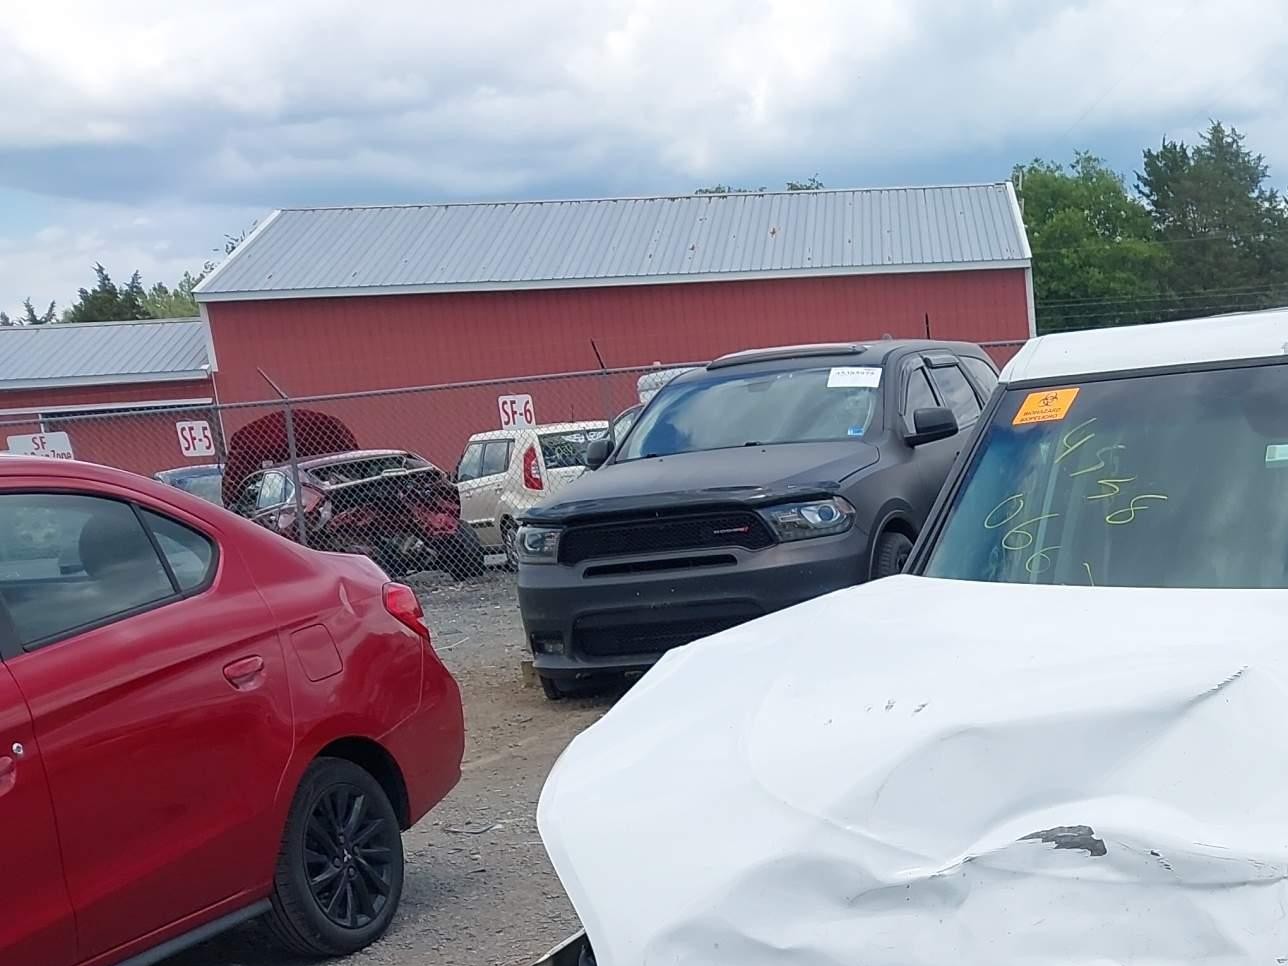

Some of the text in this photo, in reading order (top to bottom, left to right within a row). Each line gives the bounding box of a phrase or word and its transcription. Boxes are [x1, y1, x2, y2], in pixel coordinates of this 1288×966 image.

[501, 399, 533, 426] SF-6
[31, 436, 47, 451] SF
[180, 426, 212, 451] SF-5
